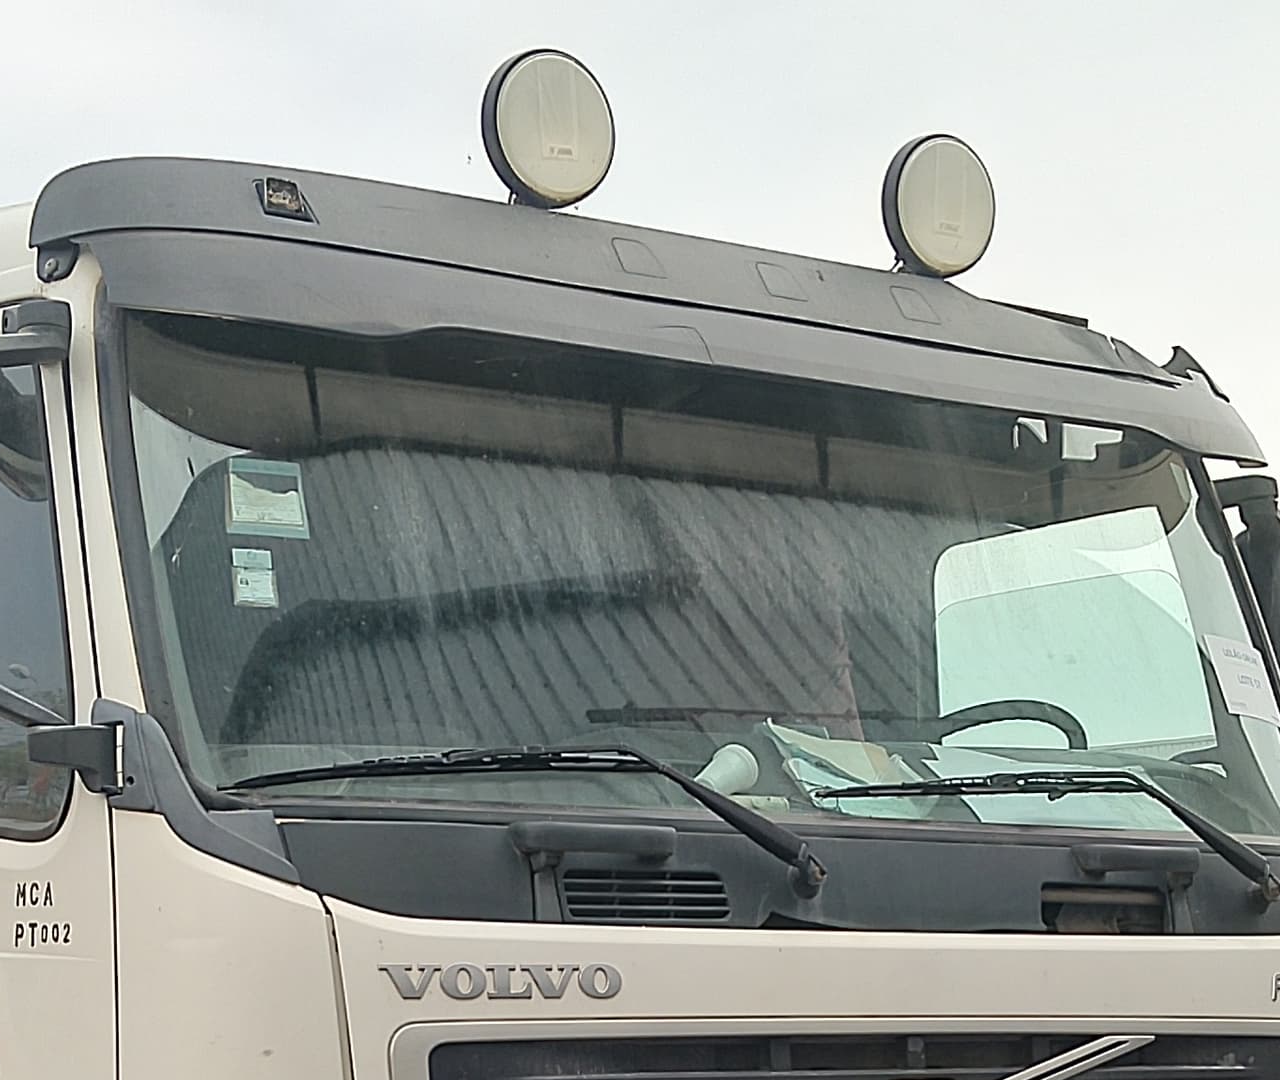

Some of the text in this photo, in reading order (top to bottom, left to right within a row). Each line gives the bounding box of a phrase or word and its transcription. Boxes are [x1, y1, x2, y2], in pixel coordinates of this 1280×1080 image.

[15, 881, 54, 907] MCA
[14, 922, 71, 948] PT002
[377, 963, 622, 1000] VOLVO
